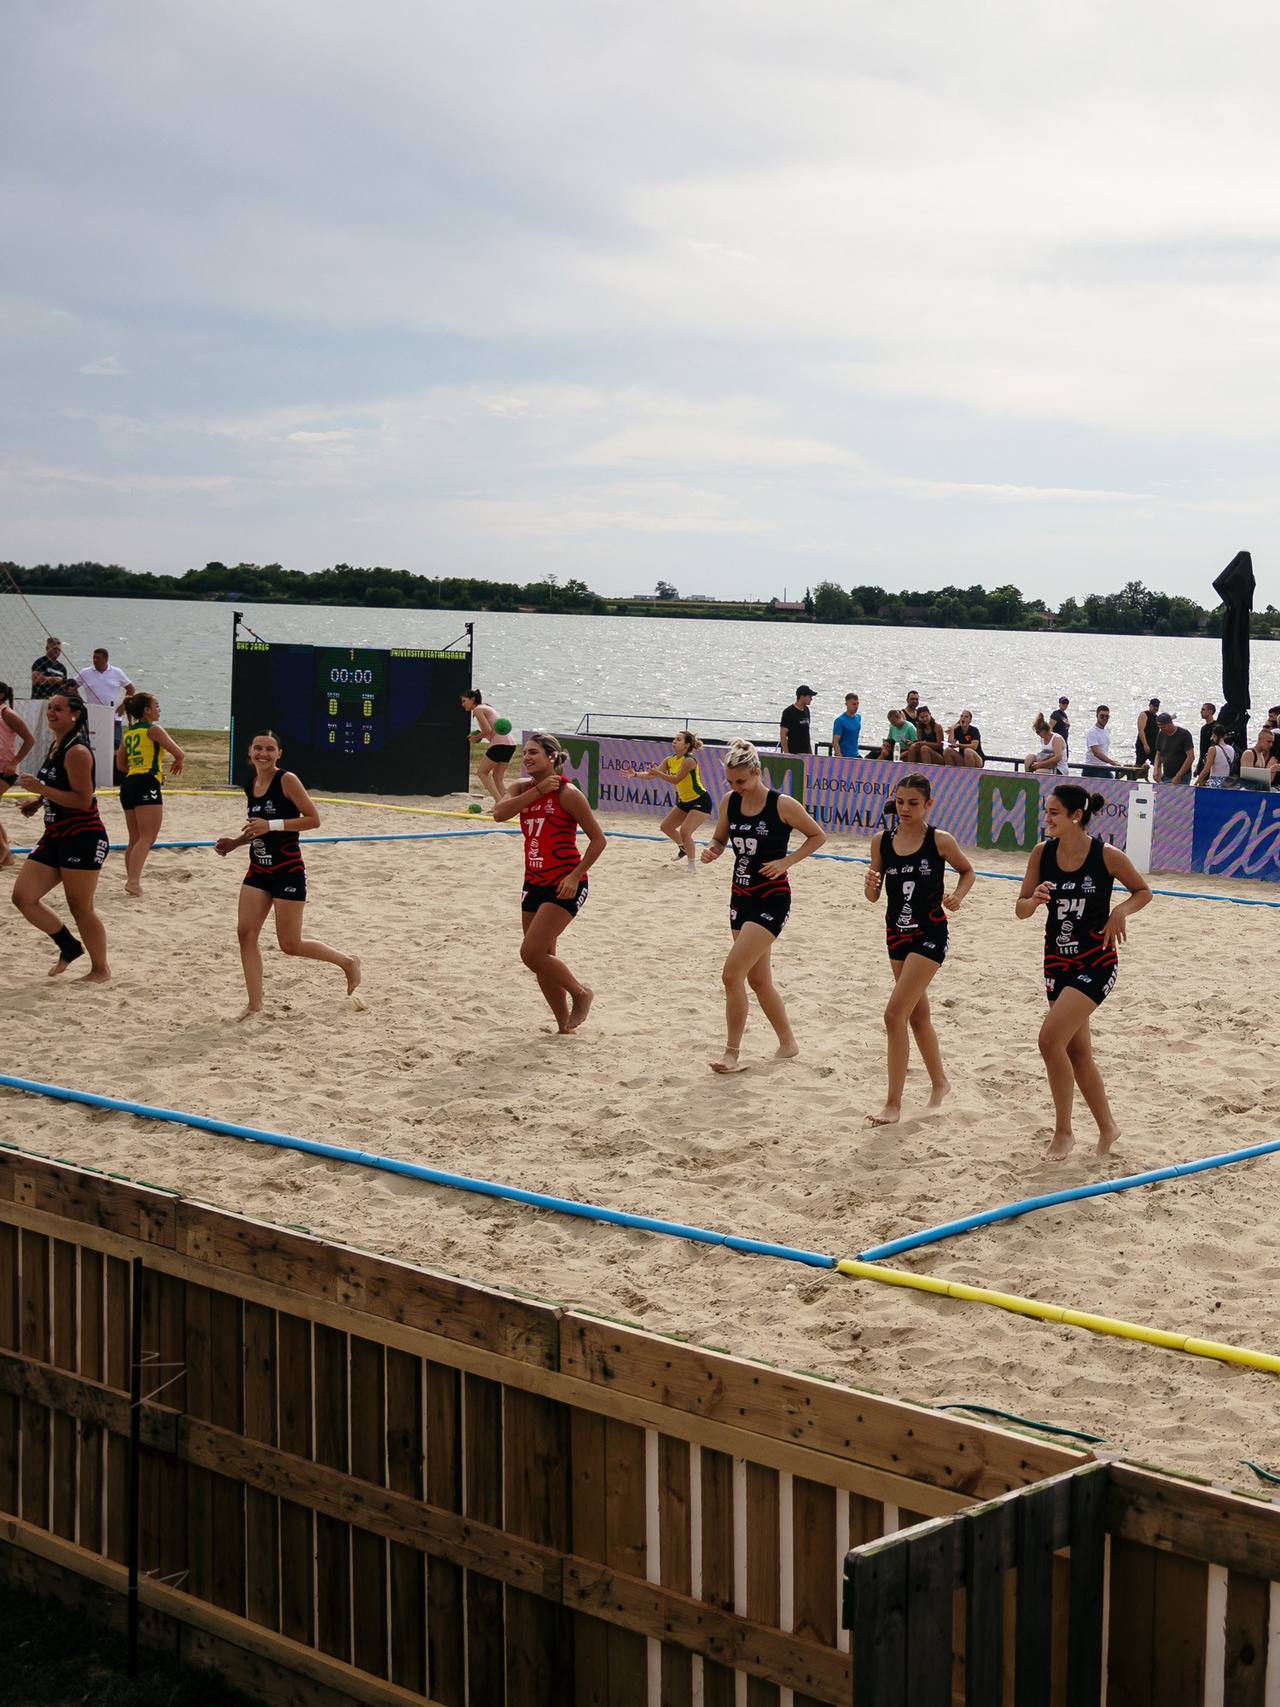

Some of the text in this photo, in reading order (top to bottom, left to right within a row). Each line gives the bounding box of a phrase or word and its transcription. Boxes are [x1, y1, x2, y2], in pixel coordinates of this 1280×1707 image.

[330, 668, 372, 684] 00:00
[328, 698, 338, 715] 0
[363, 700, 372, 717] 0
[126, 734, 142, 756] 82
[732, 836, 758, 856] 99
[902, 880, 916, 902] 9
[1056, 898, 1086, 920] 24
